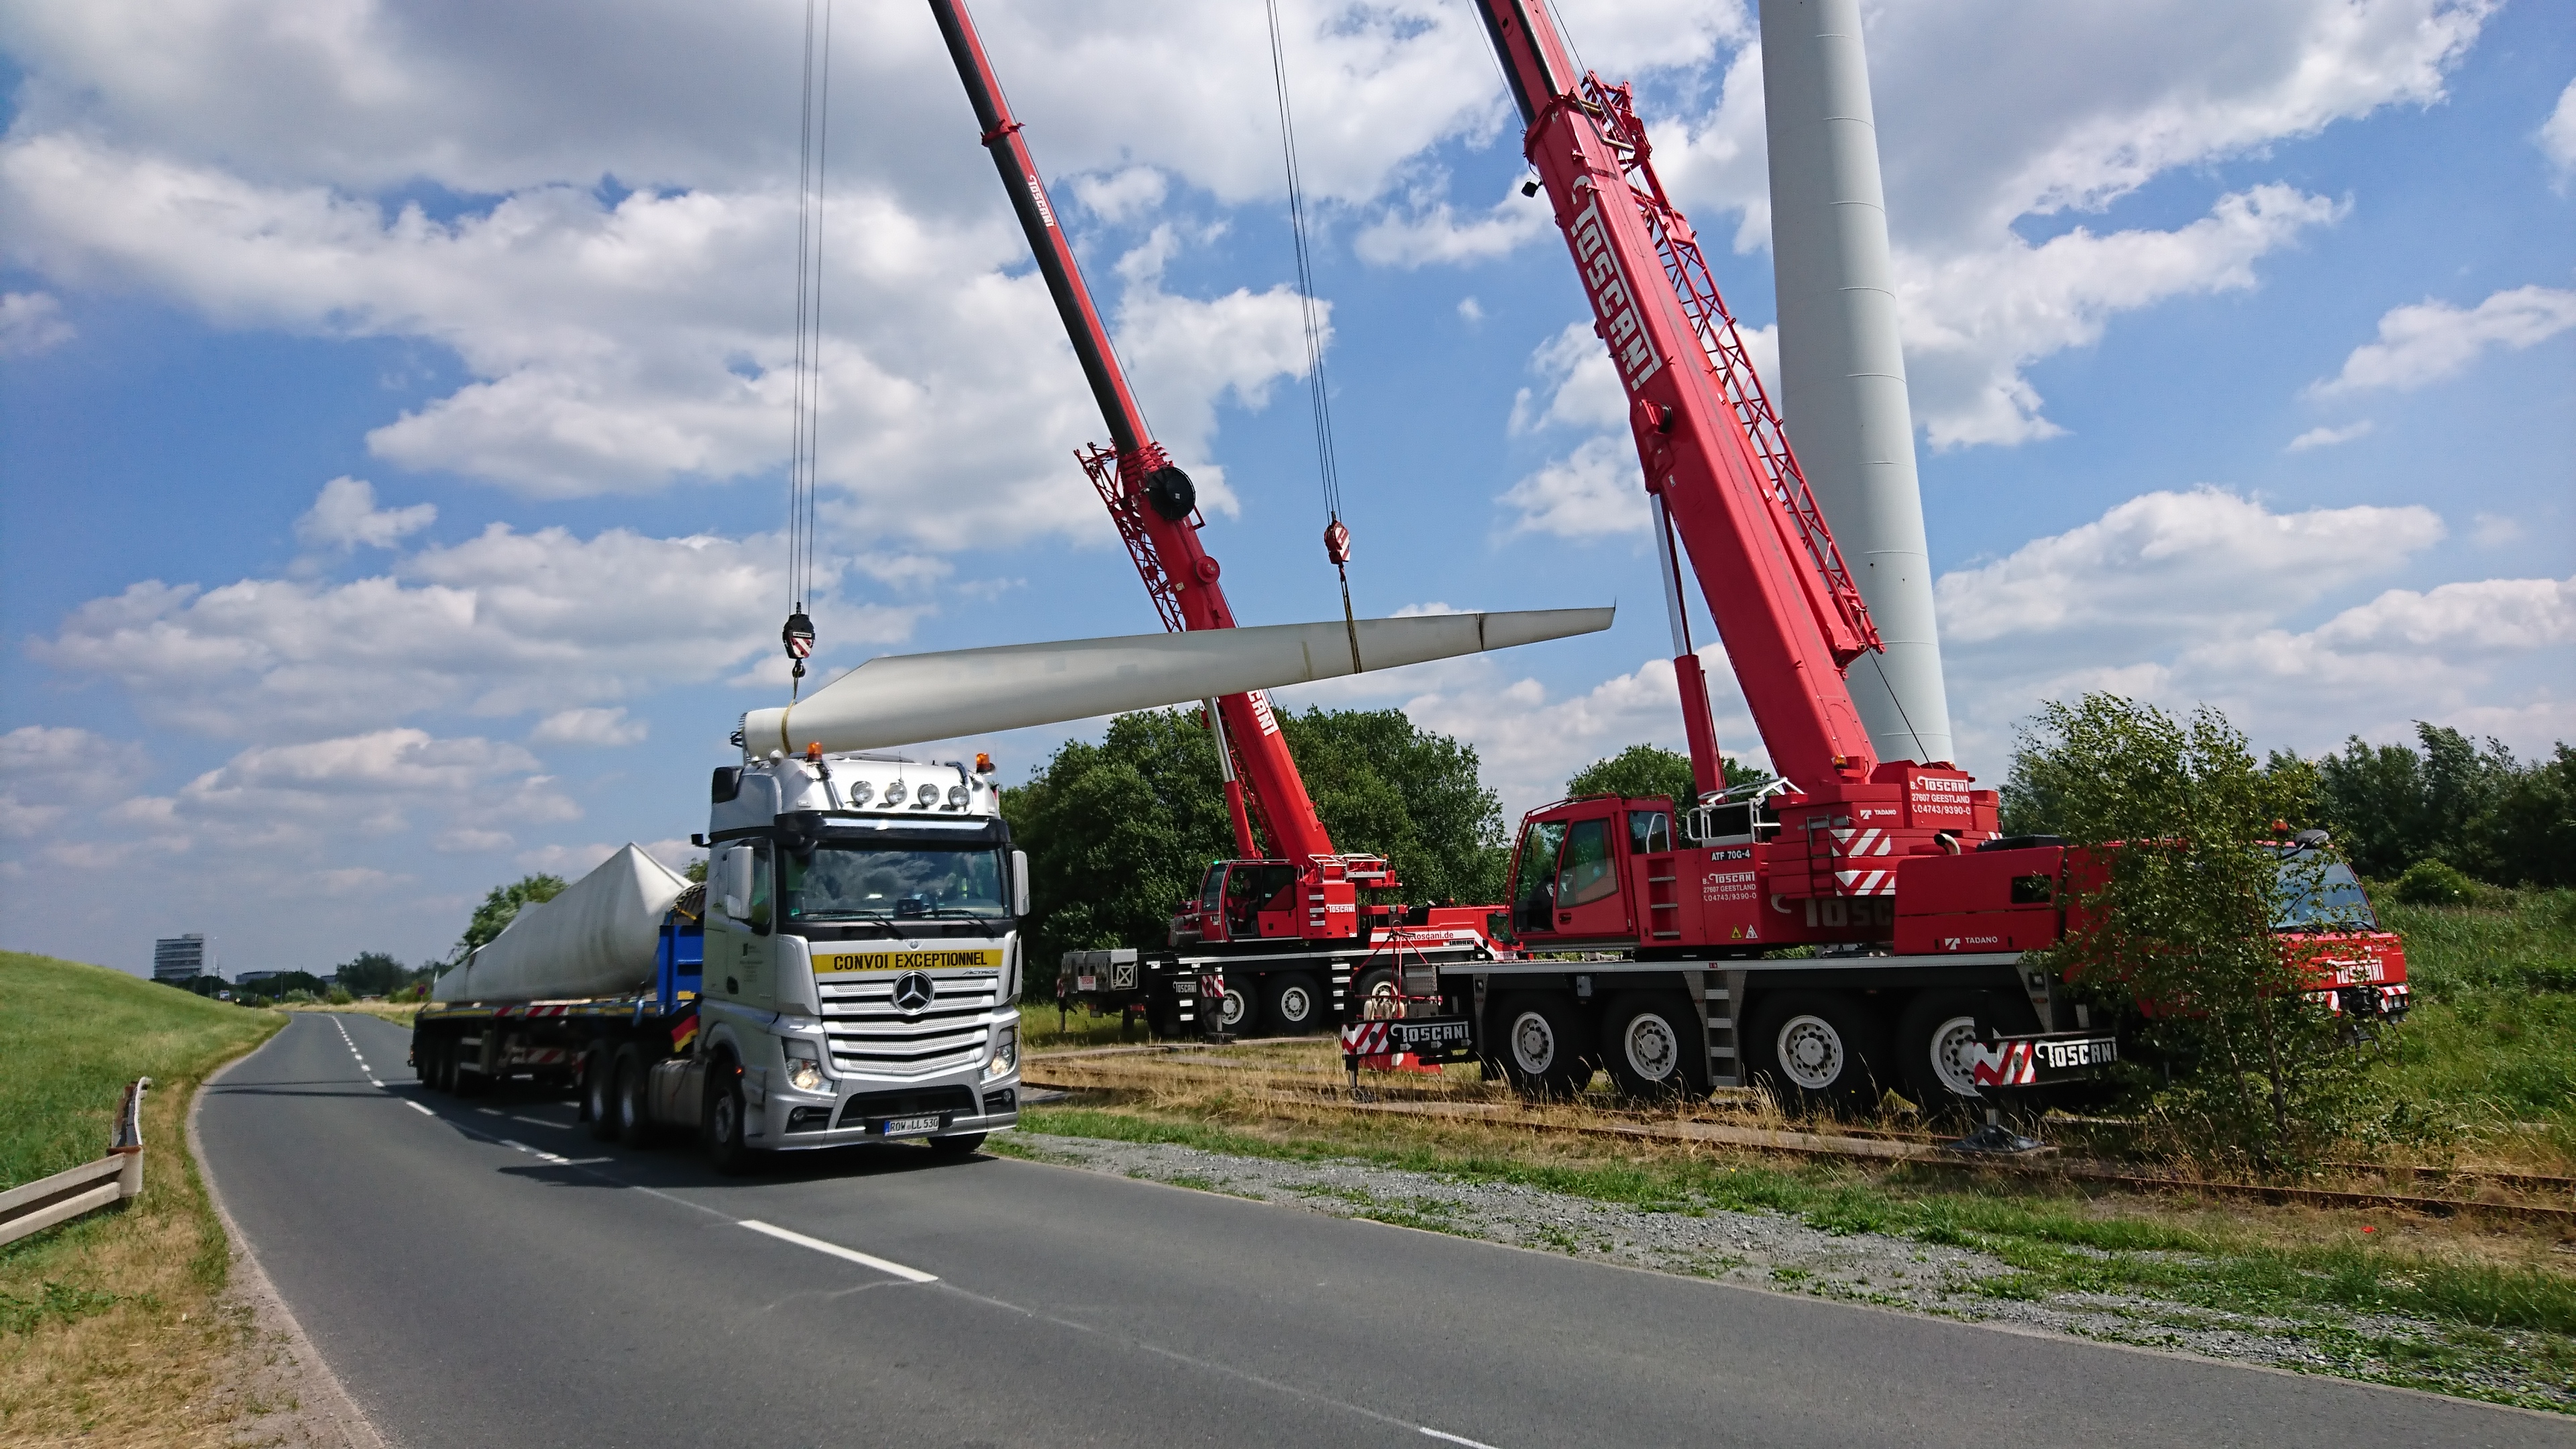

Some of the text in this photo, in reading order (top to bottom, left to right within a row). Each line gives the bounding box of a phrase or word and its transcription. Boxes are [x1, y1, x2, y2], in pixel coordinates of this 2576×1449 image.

[1028, 174, 1055, 227] TOSCANI
[1570, 175, 1662, 392] TOSCANI
[1246, 689, 1279, 737] CANI
[1910, 775, 1969, 793] B. TOSCANI
[1912, 794, 1970, 804] 27607 GEESTLAND
[1711, 849, 1750, 861] ATF 70G-4
[1709, 871, 1756, 883] TOSCANI
[1720, 883, 1756, 892] GEESTLAND
[1708, 892, 1757, 902] 04743/9390-0
[1326, 904, 1355, 913] TOSCANI
[1771, 894, 1893, 927] TOSC
[1965, 936, 1998, 944] TADANO
[834, 951, 987, 971] CONVOI EXCEPTIONNEL
[1173, 981, 1197, 993] TOSCANI
[1390, 1021, 1469, 1042] TOSCANI
[2035, 1036, 2117, 1068] TOSCANI
[890, 1118, 938, 1132] ROW LL 530
